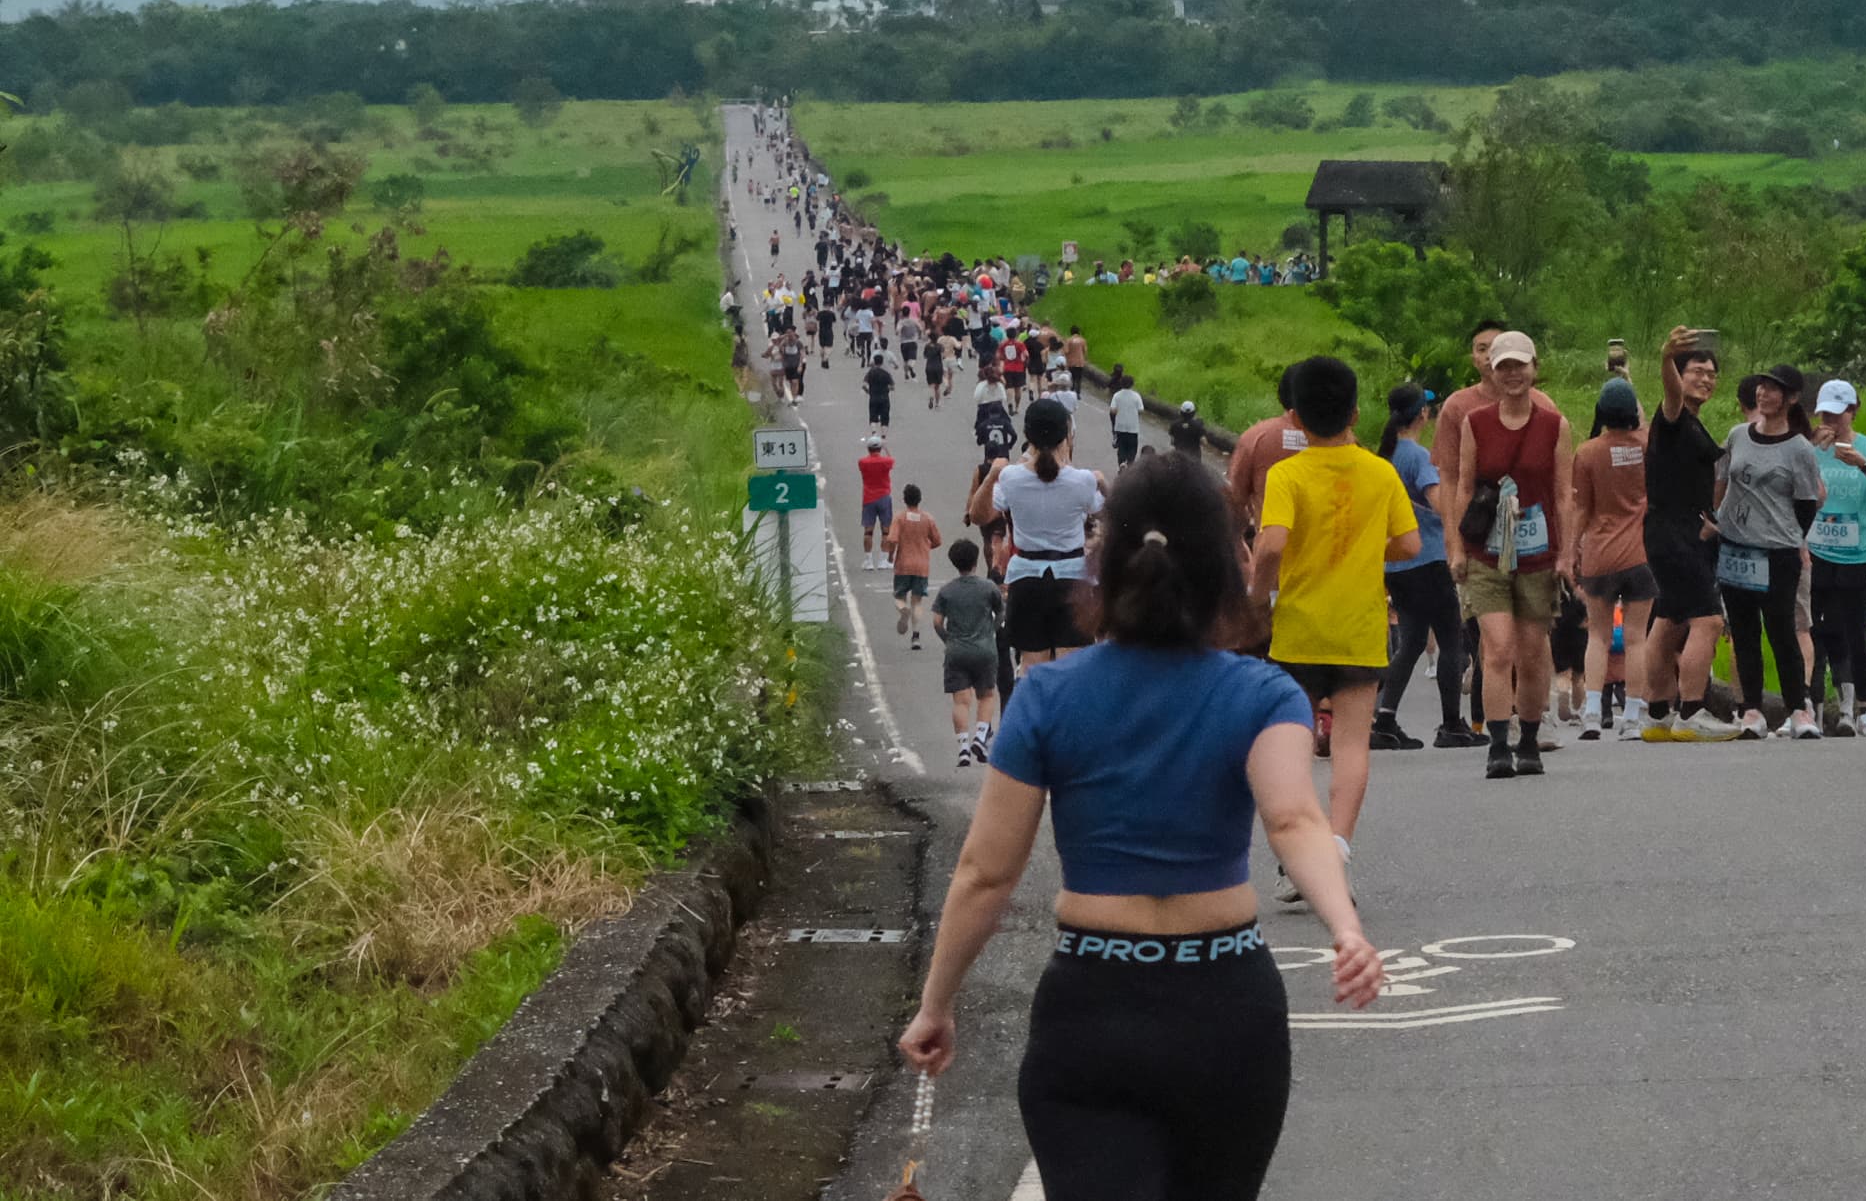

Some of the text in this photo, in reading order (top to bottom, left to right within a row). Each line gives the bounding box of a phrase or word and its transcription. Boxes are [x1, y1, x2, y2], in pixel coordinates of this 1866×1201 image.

[761, 441, 797, 457] 東13
[775, 482, 789, 503] 2
[1816, 523, 1848, 537] 5068
[1077, 935, 1166, 963] PRO
[1209, 923, 1264, 961] PRO
